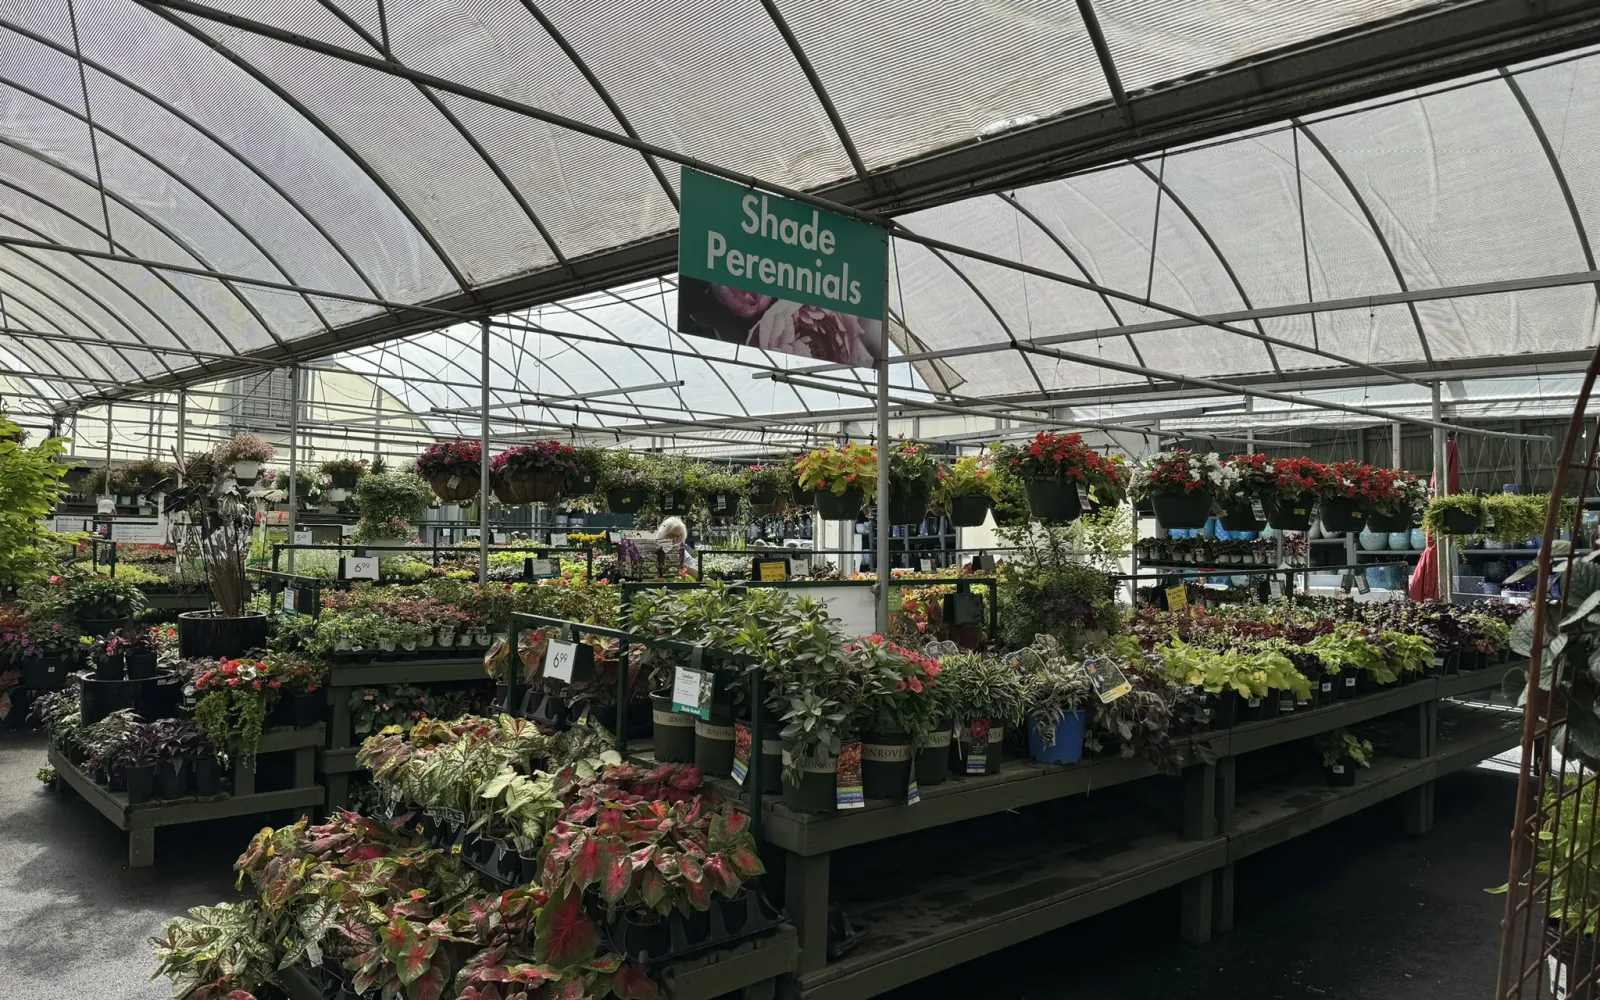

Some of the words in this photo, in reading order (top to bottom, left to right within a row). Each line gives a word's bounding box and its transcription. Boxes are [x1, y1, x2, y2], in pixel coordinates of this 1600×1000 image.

[741, 194, 836, 256] Shade
[707, 230, 862, 305] Perennials
[354, 562, 370, 573] 699
[553, 652, 568, 668] 699
[862, 748, 910, 758] ONROVIA
